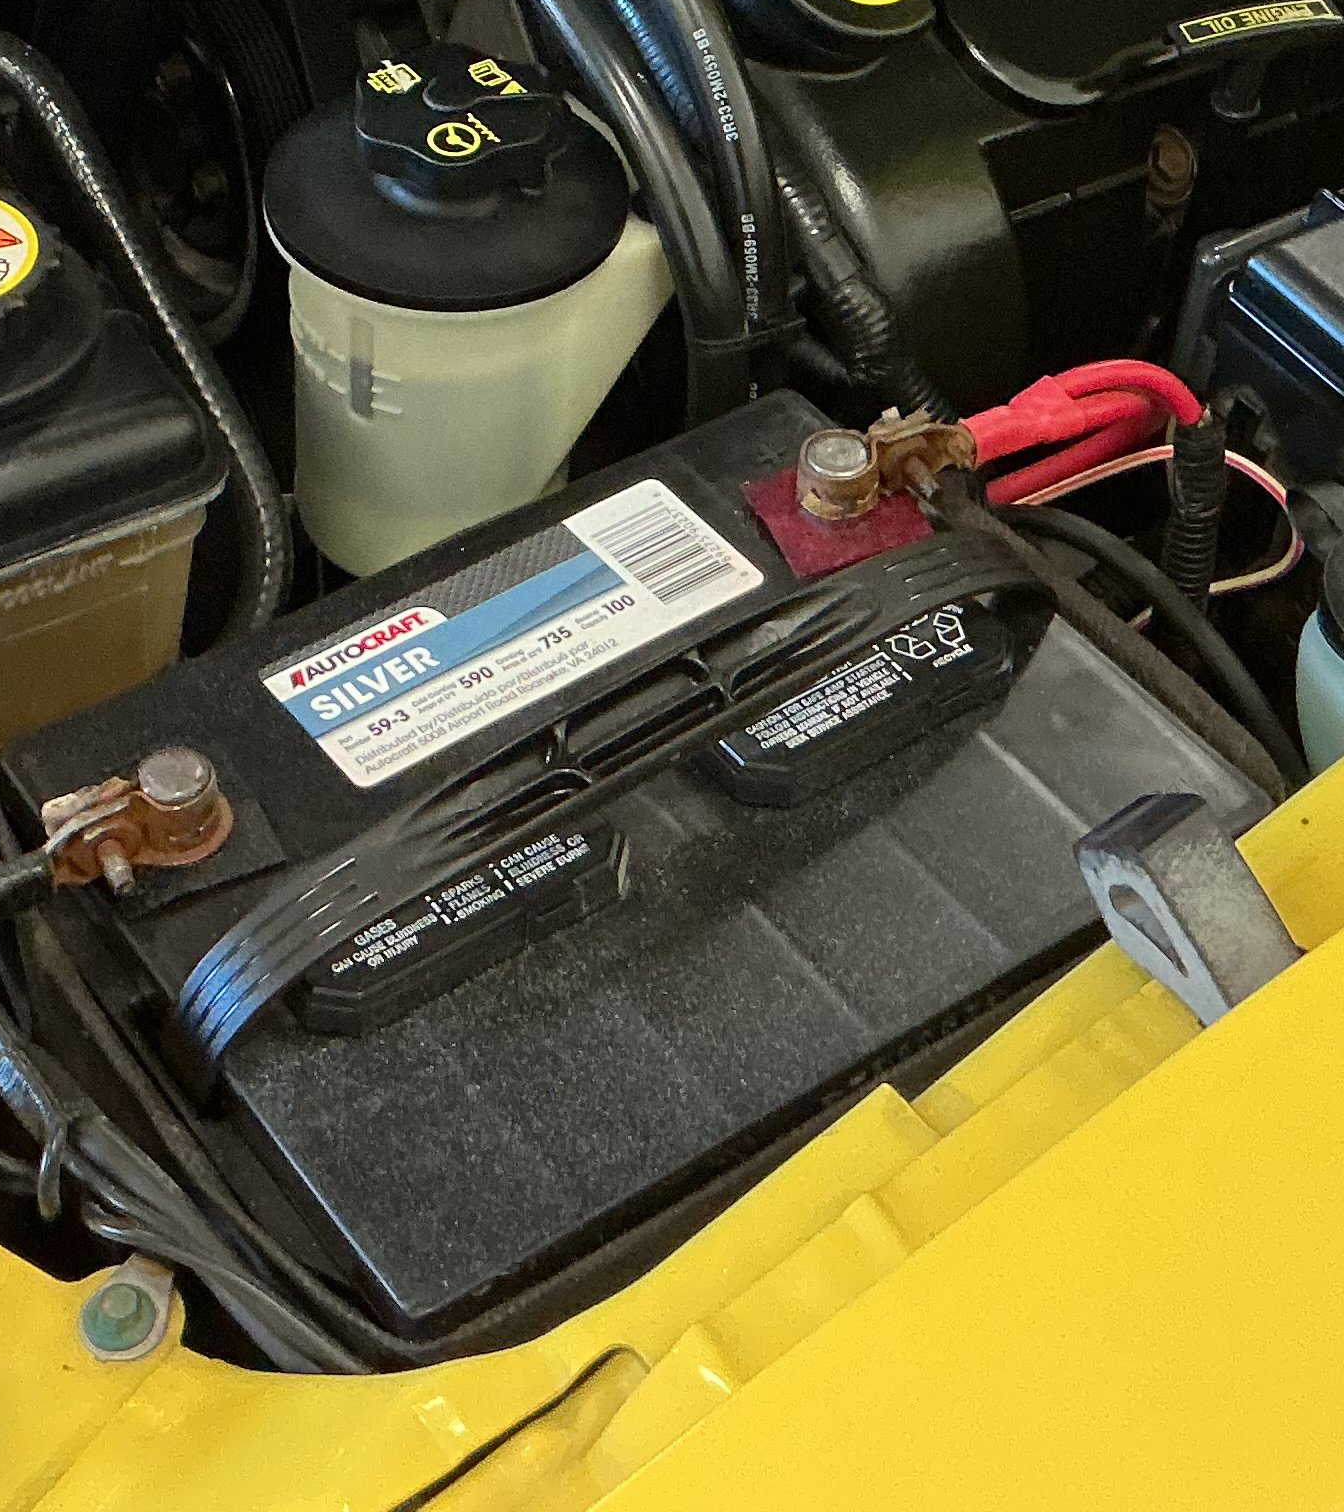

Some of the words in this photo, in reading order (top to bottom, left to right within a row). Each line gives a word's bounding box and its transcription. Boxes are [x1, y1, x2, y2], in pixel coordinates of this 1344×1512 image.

[1200, 16, 1236, 34] OIL
[1239, 3, 1314, 26] ENGINE
[692, 28, 739, 143] 3R33-2M059-BB
[741, 213, 759, 320] 3R33-2M059-BB
[602, 595, 635, 614] 100
[306, 613, 424, 680] AUTOCRAFT
[538, 627, 572, 649] 735
[311, 647, 440, 720] SILVER
[459, 666, 494, 689] 590
[355, 729, 418, 766] Distributed
[568, 641, 588, 657] par
[366, 743, 418, 775] Autocraft
[448, 707, 486, 731] Airport
[488, 690, 518, 710] Road
[566, 657, 586, 667] VA
[584, 639, 618, 659] 24012
[368, 710, 409, 735] 59-3
[501, 852, 524, 868] CAN
[524, 834, 560, 856] CAUSE
[508, 844, 565, 877] BLINDNESS
[567, 835, 584, 846] OR
[441, 875, 483, 901] SPARKS
[516, 861, 556, 886] SEVERE
[448, 885, 490, 910] FLAMES
[457, 889, 505, 919] SMOKING
[332, 958, 353, 972] CAN
[353, 941, 386, 962] CAUSE
[384, 913, 437, 945] BLINDNESS
[354, 919, 396, 945] GASES
[368, 954, 384, 967] OR
[383, 935, 418, 958] INJURY
